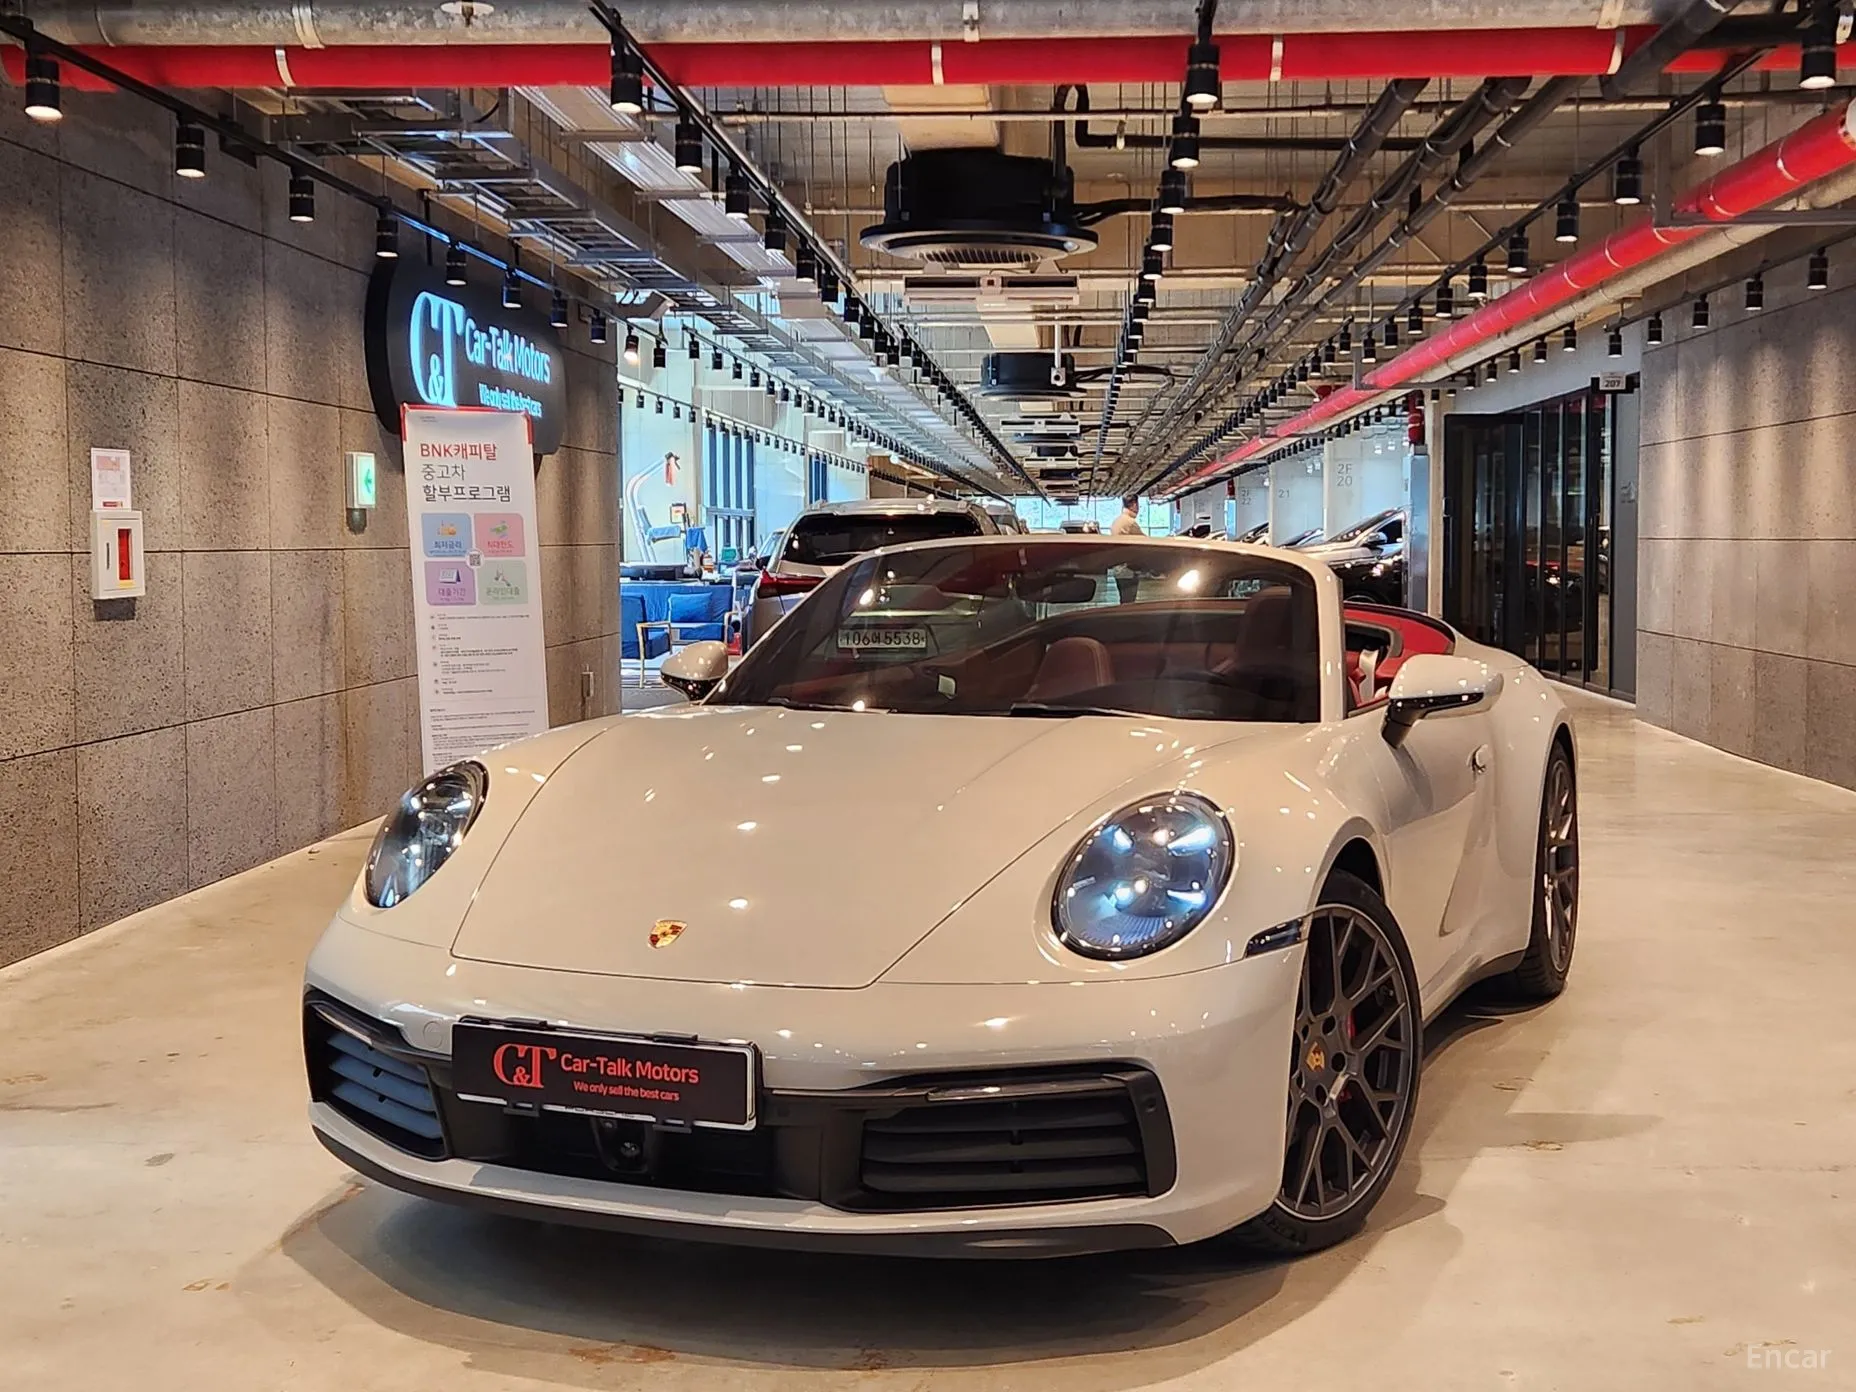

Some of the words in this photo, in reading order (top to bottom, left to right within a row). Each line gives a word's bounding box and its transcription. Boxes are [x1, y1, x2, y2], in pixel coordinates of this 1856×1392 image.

[465, 318, 514, 374] Car-Talk
[514, 334, 551, 384] Motors
[1604, 380, 1621, 388] 207
[420, 443, 497, 461] BNK캐피탈
[421, 463, 466, 481] 중고차
[1337, 463, 1353, 474] 2F
[1337, 475, 1353, 487] 20
[423, 485, 511, 502] 할부프로그램
[1278, 489, 1291, 498] 21
[560, 1053, 632, 1078] Car-Talk
[636, 1060, 699, 1084] Motors
[573, 1081, 588, 1092] We
[589, 1083, 608, 1096] only
[608, 1085, 623, 1096] sell
[624, 1086, 639, 1097] the
[640, 1087, 659, 1100] best
[660, 1090, 680, 1101] cars
